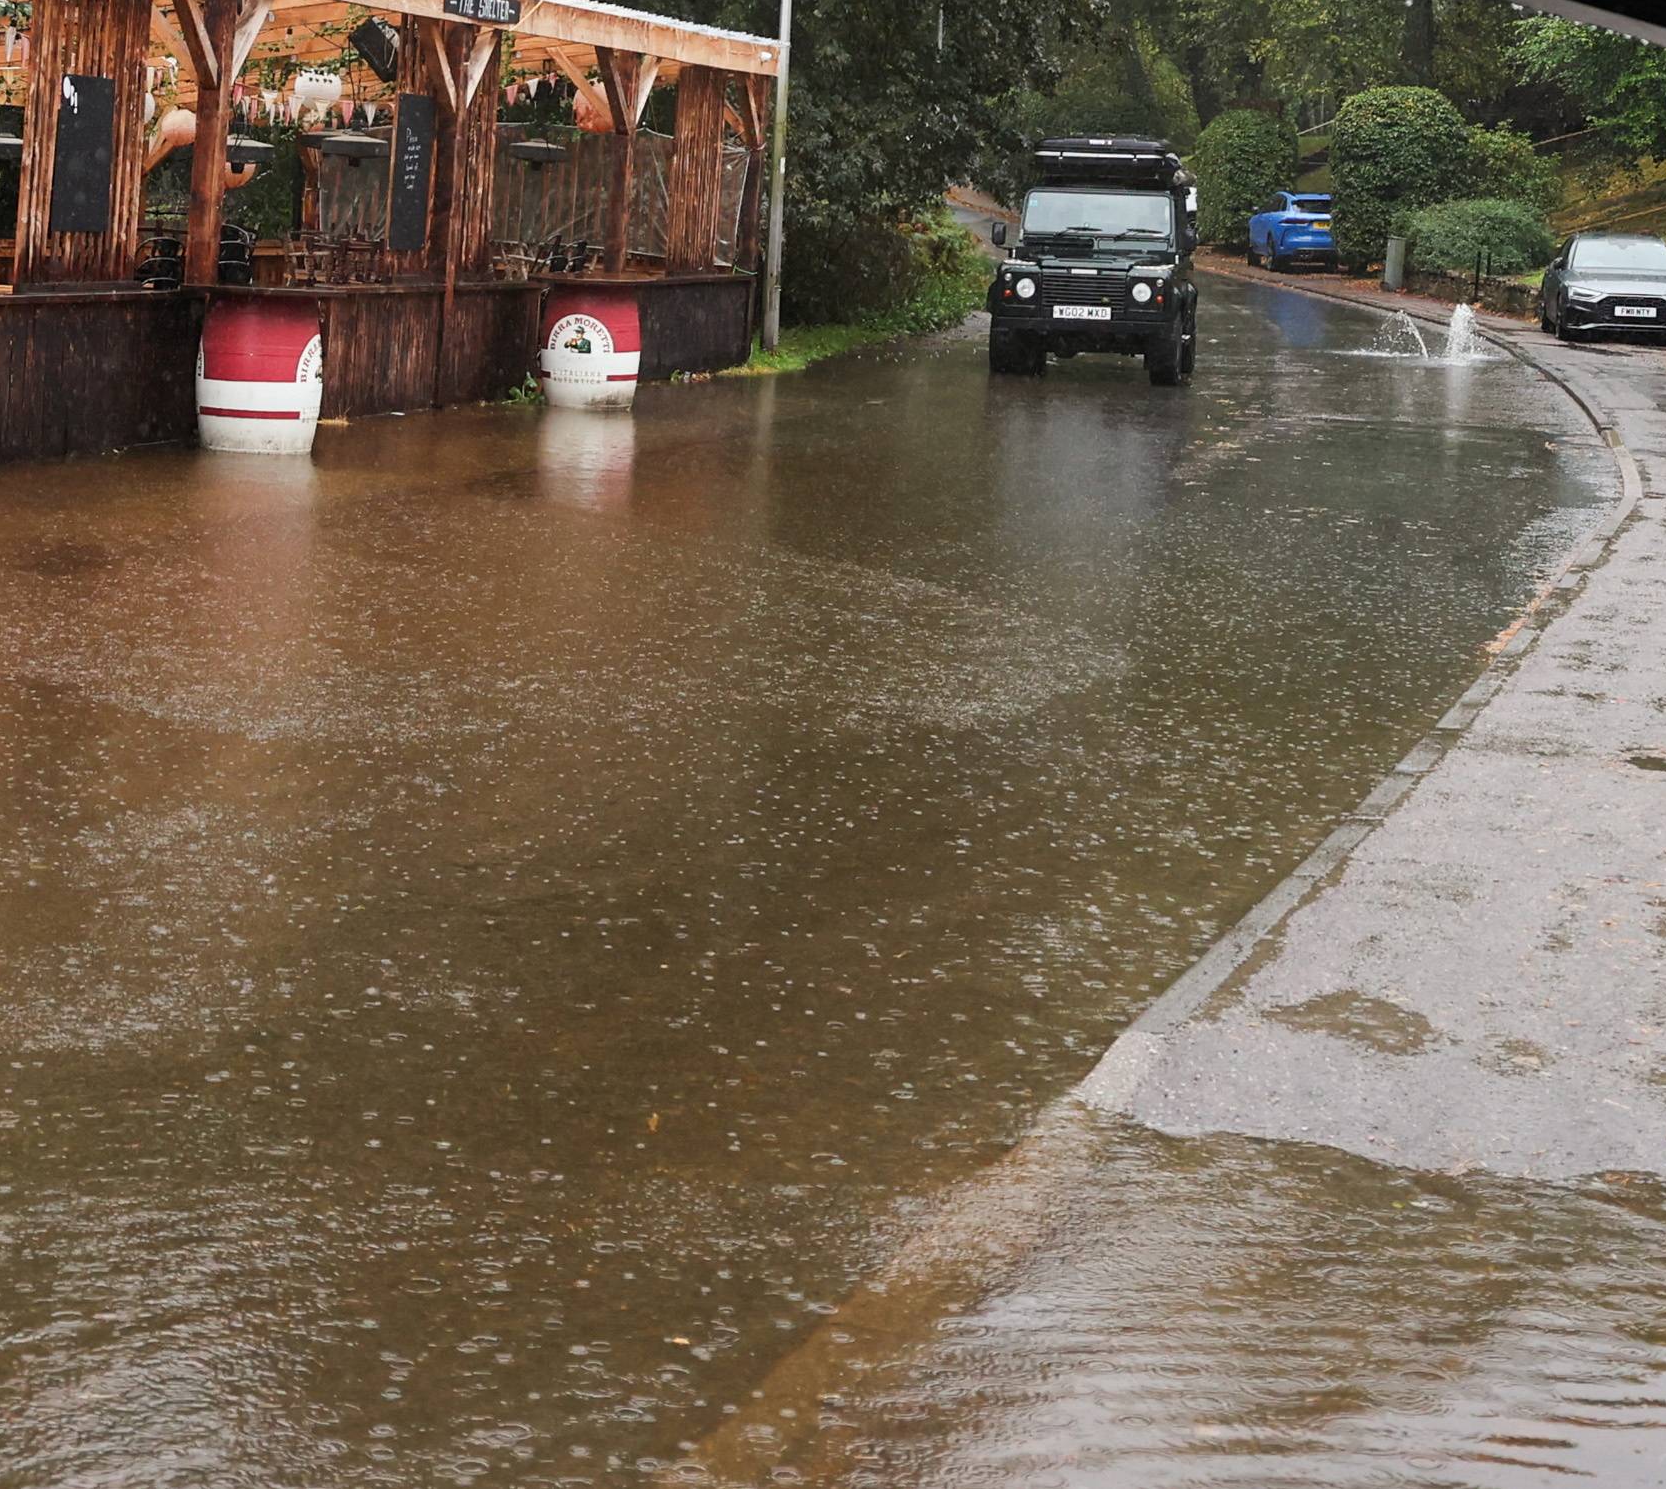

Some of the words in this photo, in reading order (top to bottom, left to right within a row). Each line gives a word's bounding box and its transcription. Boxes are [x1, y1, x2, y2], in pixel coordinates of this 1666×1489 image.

[1058, 307, 1084, 317] WG02
[1087, 308, 1107, 318] MXD
[550, 320, 572, 350] BIRRA
[574, 317, 611, 353] MORETTI
